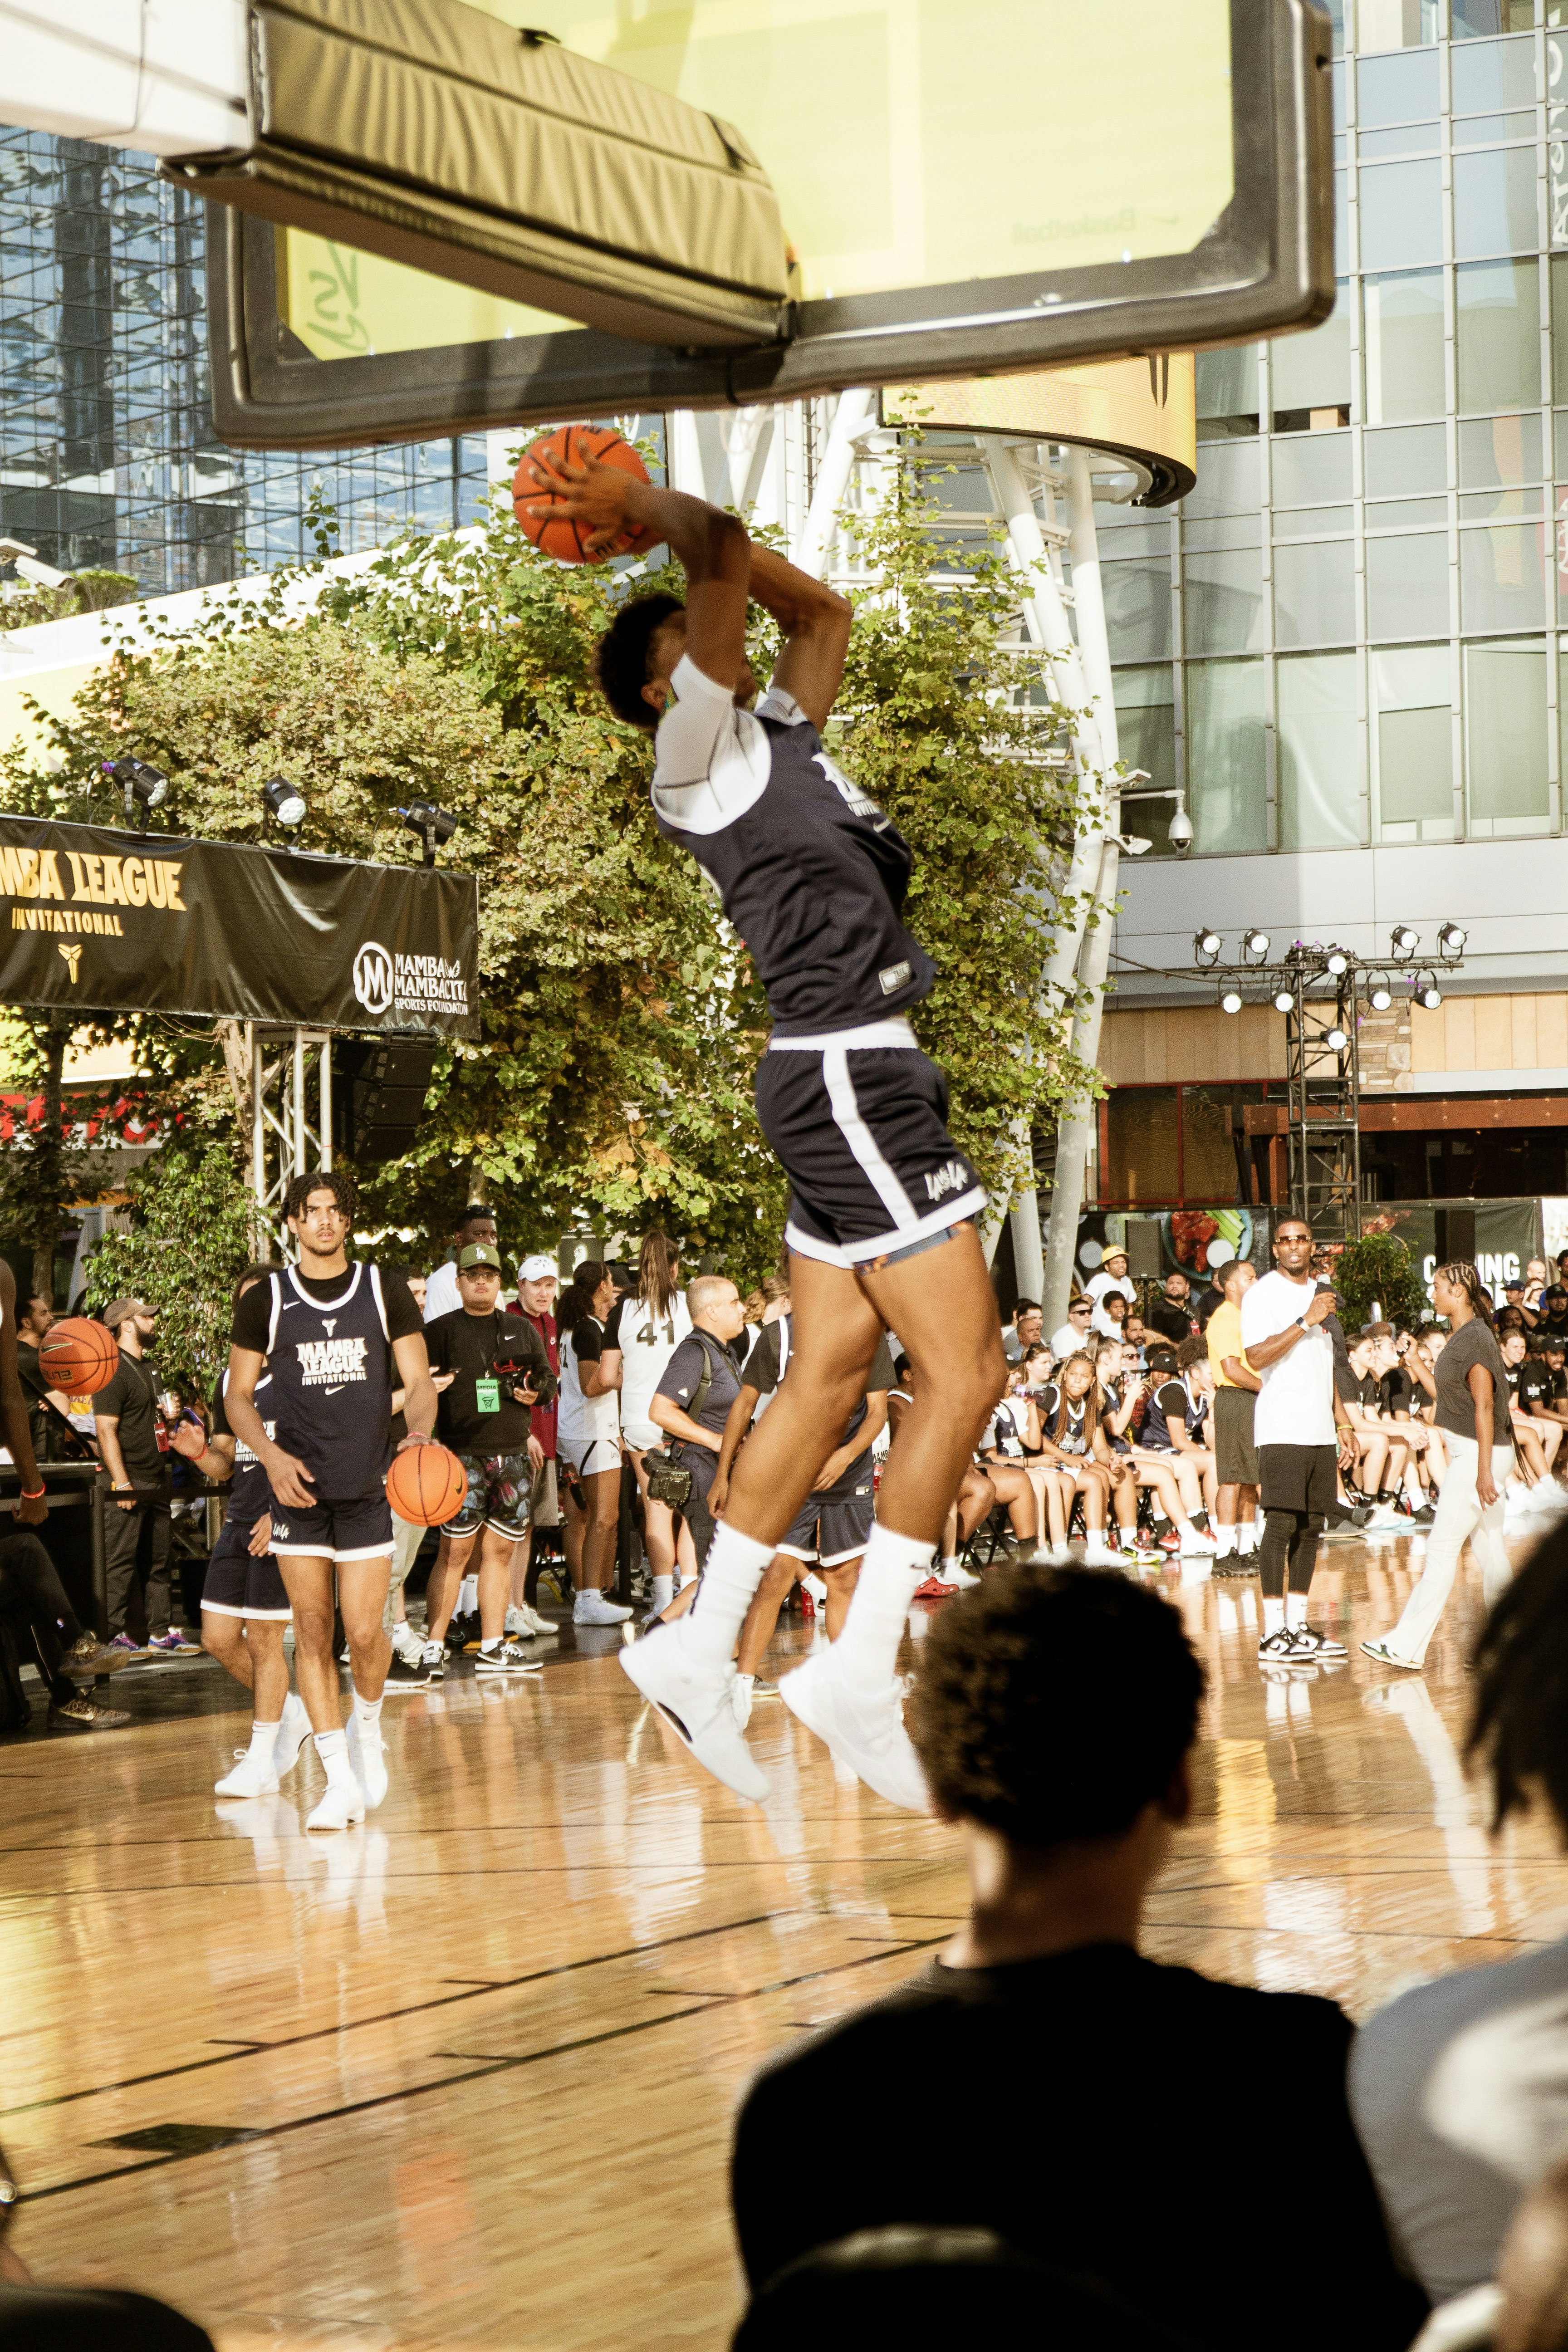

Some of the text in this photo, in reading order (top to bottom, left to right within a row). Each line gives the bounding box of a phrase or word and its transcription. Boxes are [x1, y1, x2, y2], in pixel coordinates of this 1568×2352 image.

[65, 852, 187, 911] LEAGUE
[12, 908, 124, 936] INVITATIONAL
[394, 953, 446, 978] MAMBA
[394, 975, 468, 1001] MAMBACITA
[394, 997, 426, 1011] SPORTS
[475, 1247, 487, 1260] LA
[1423, 1253, 1520, 1284] CING
[636, 1320, 675, 1347] 41
[295, 1338, 368, 1362] MAMBA
[300, 1355, 366, 1377] LEAGUE
[302, 1372, 368, 1386] INVITATIONAL
